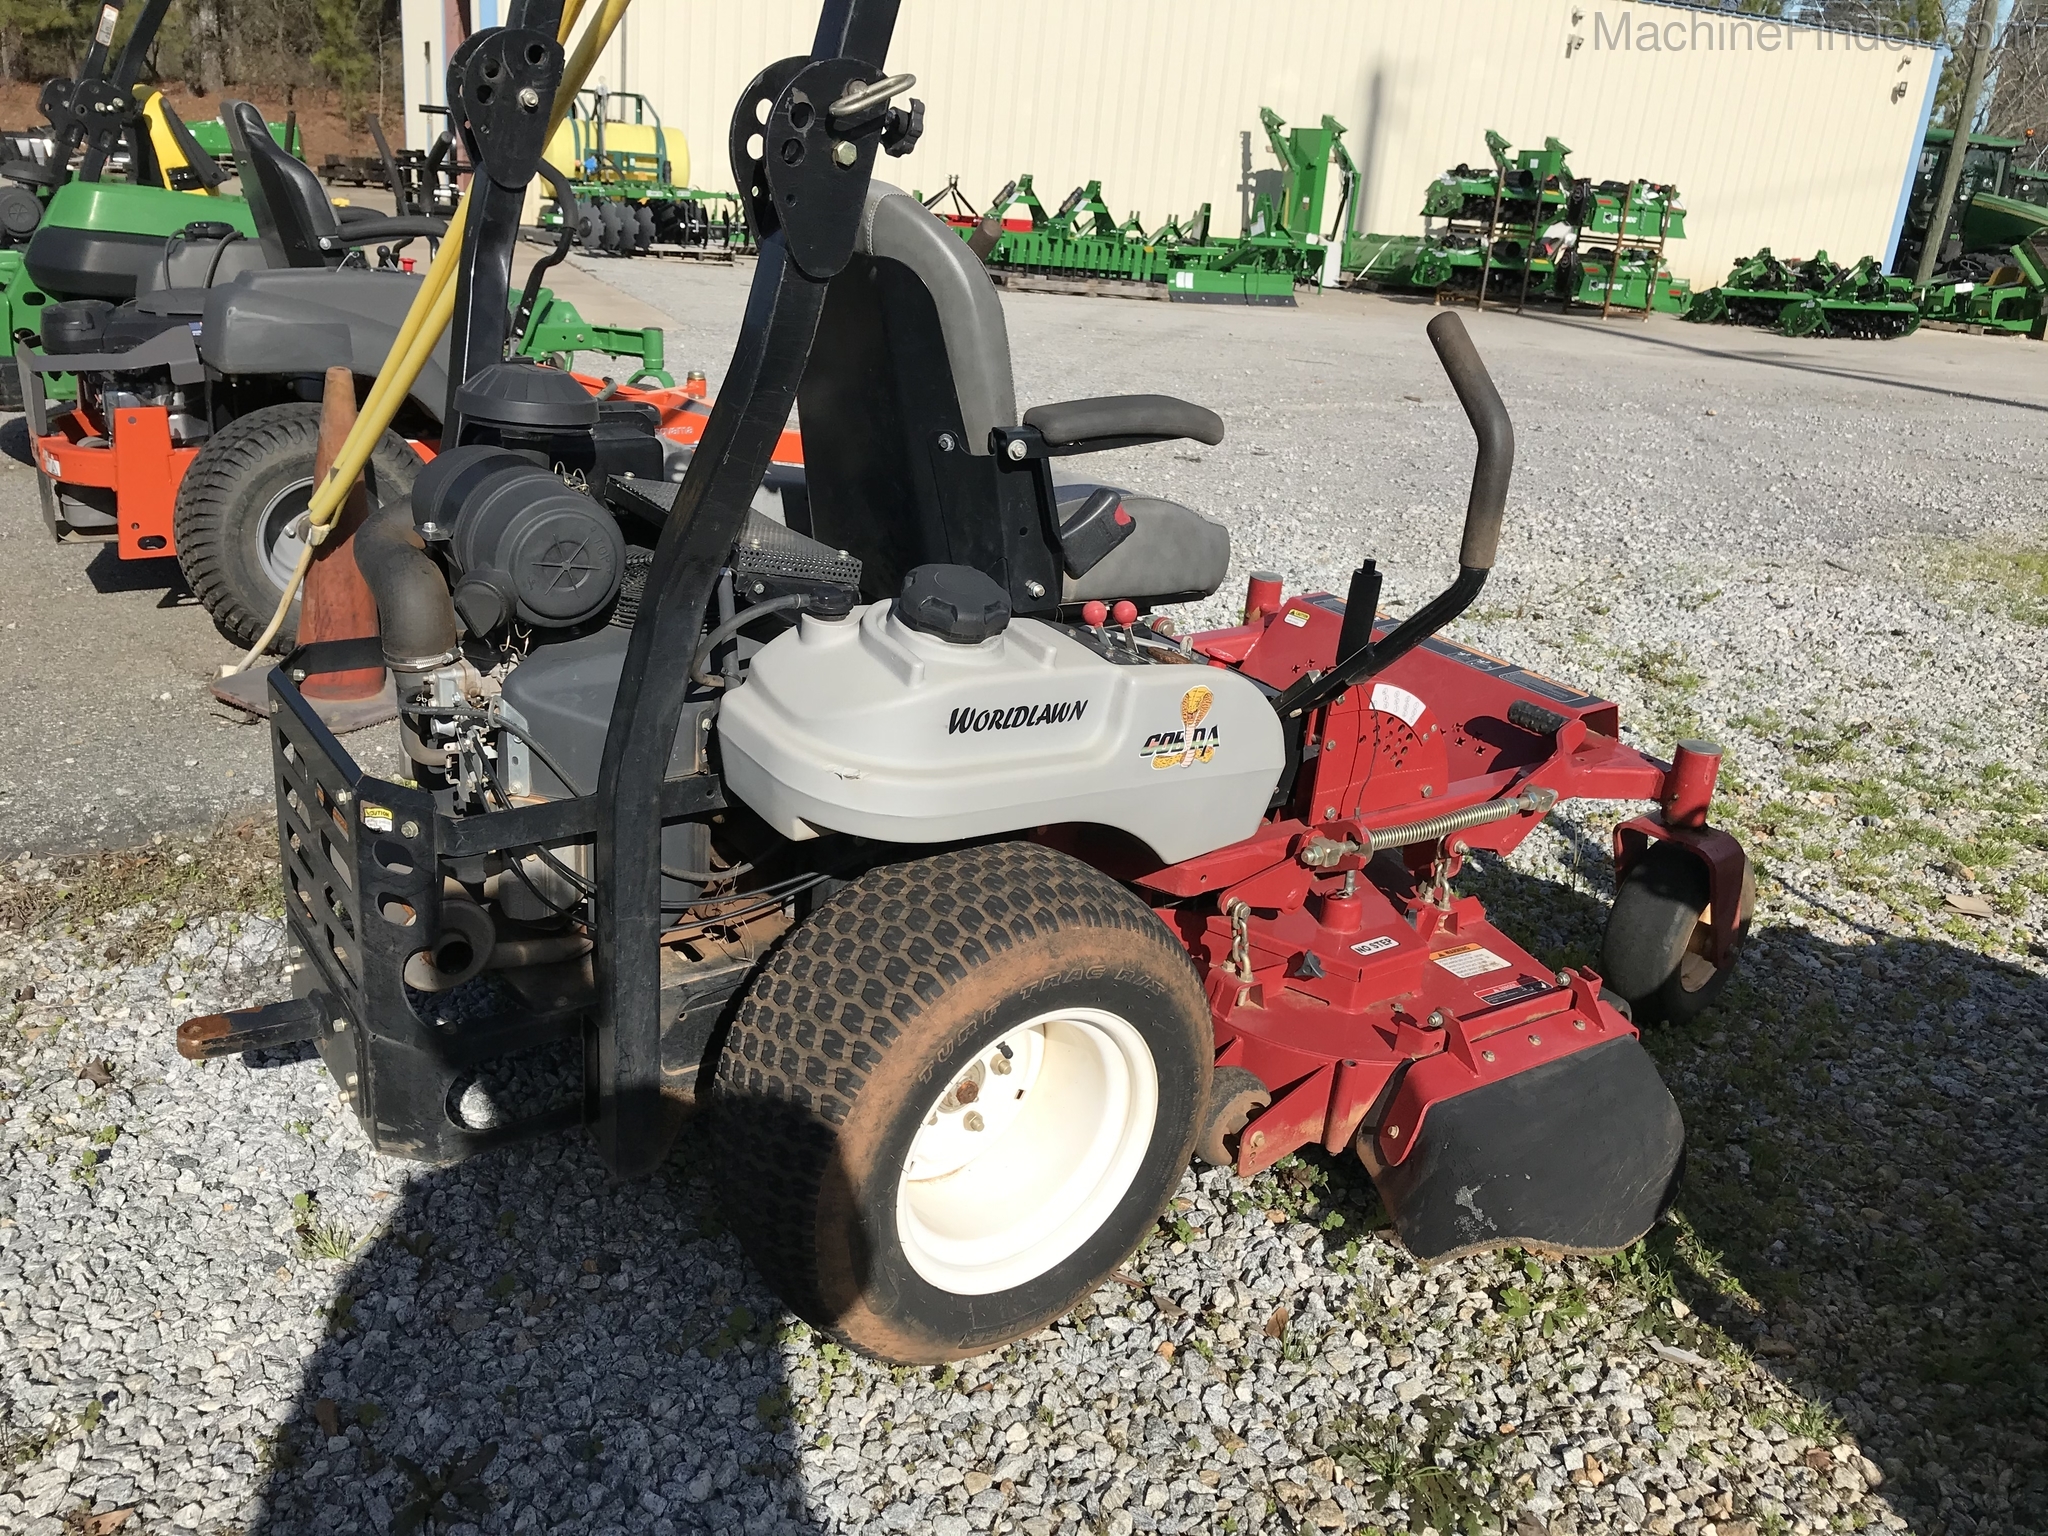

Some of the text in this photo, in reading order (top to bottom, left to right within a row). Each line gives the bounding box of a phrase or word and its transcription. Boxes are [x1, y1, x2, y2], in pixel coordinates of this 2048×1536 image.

[949, 699, 1088, 735] WORLDLAWN
[1355, 938, 1392, 953] NO STEP
[918, 1001, 1001, 1084] TURF
[1019, 965, 1107, 1000] TRAC
